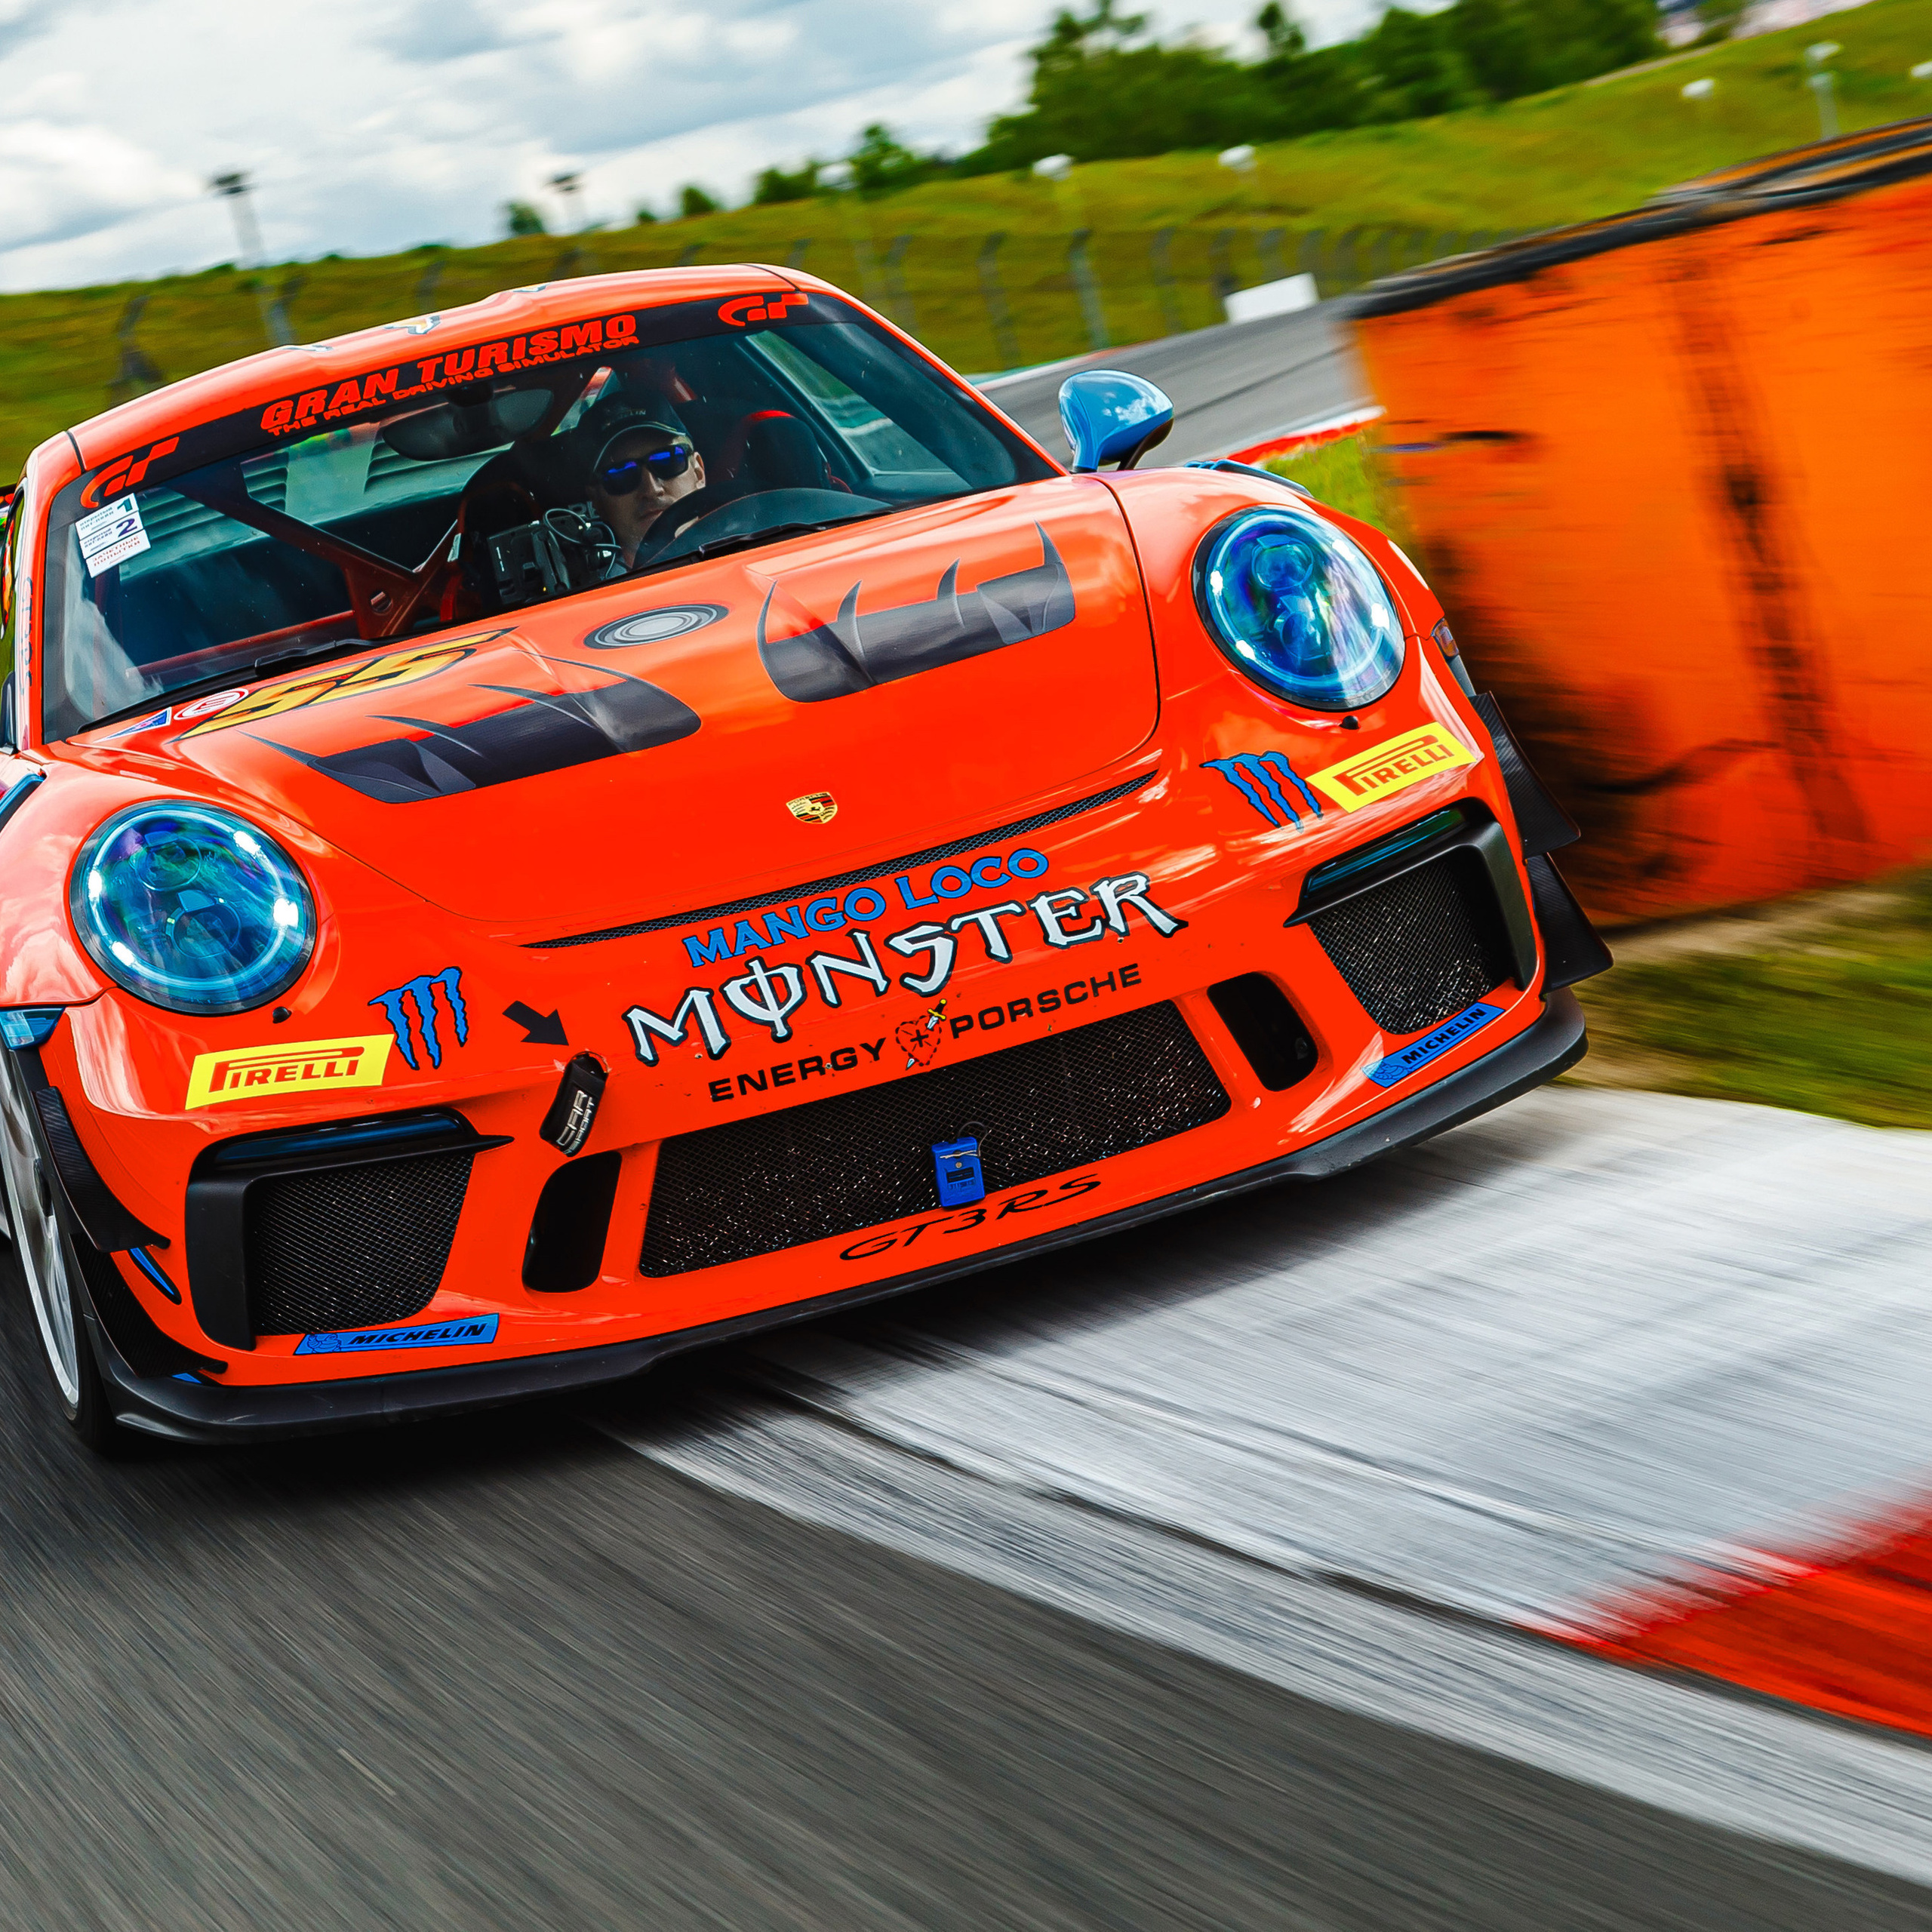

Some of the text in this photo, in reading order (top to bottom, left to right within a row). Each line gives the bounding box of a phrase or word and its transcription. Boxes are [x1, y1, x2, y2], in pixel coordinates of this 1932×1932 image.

[260, 314, 637, 430] GRAN TURISMO
[267, 335, 640, 436] THE REAL DRIVING SIMULATOR
[115, 518, 137, 538] 2
[117, 497, 133, 512] 1
[1333, 734, 1454, 796] PIRELLI
[681, 848, 1050, 968] MANGO LOCO
[623, 872, 1189, 1067] MONSTER
[708, 963, 1143, 1103] ENERGY PORSCHE
[1401, 1008, 1487, 1065] MICHELIN
[208, 1046, 365, 1094] PIRELLI
[555, 1090, 589, 1146] CAR
[349, 1321, 488, 1346] MICHELIN
